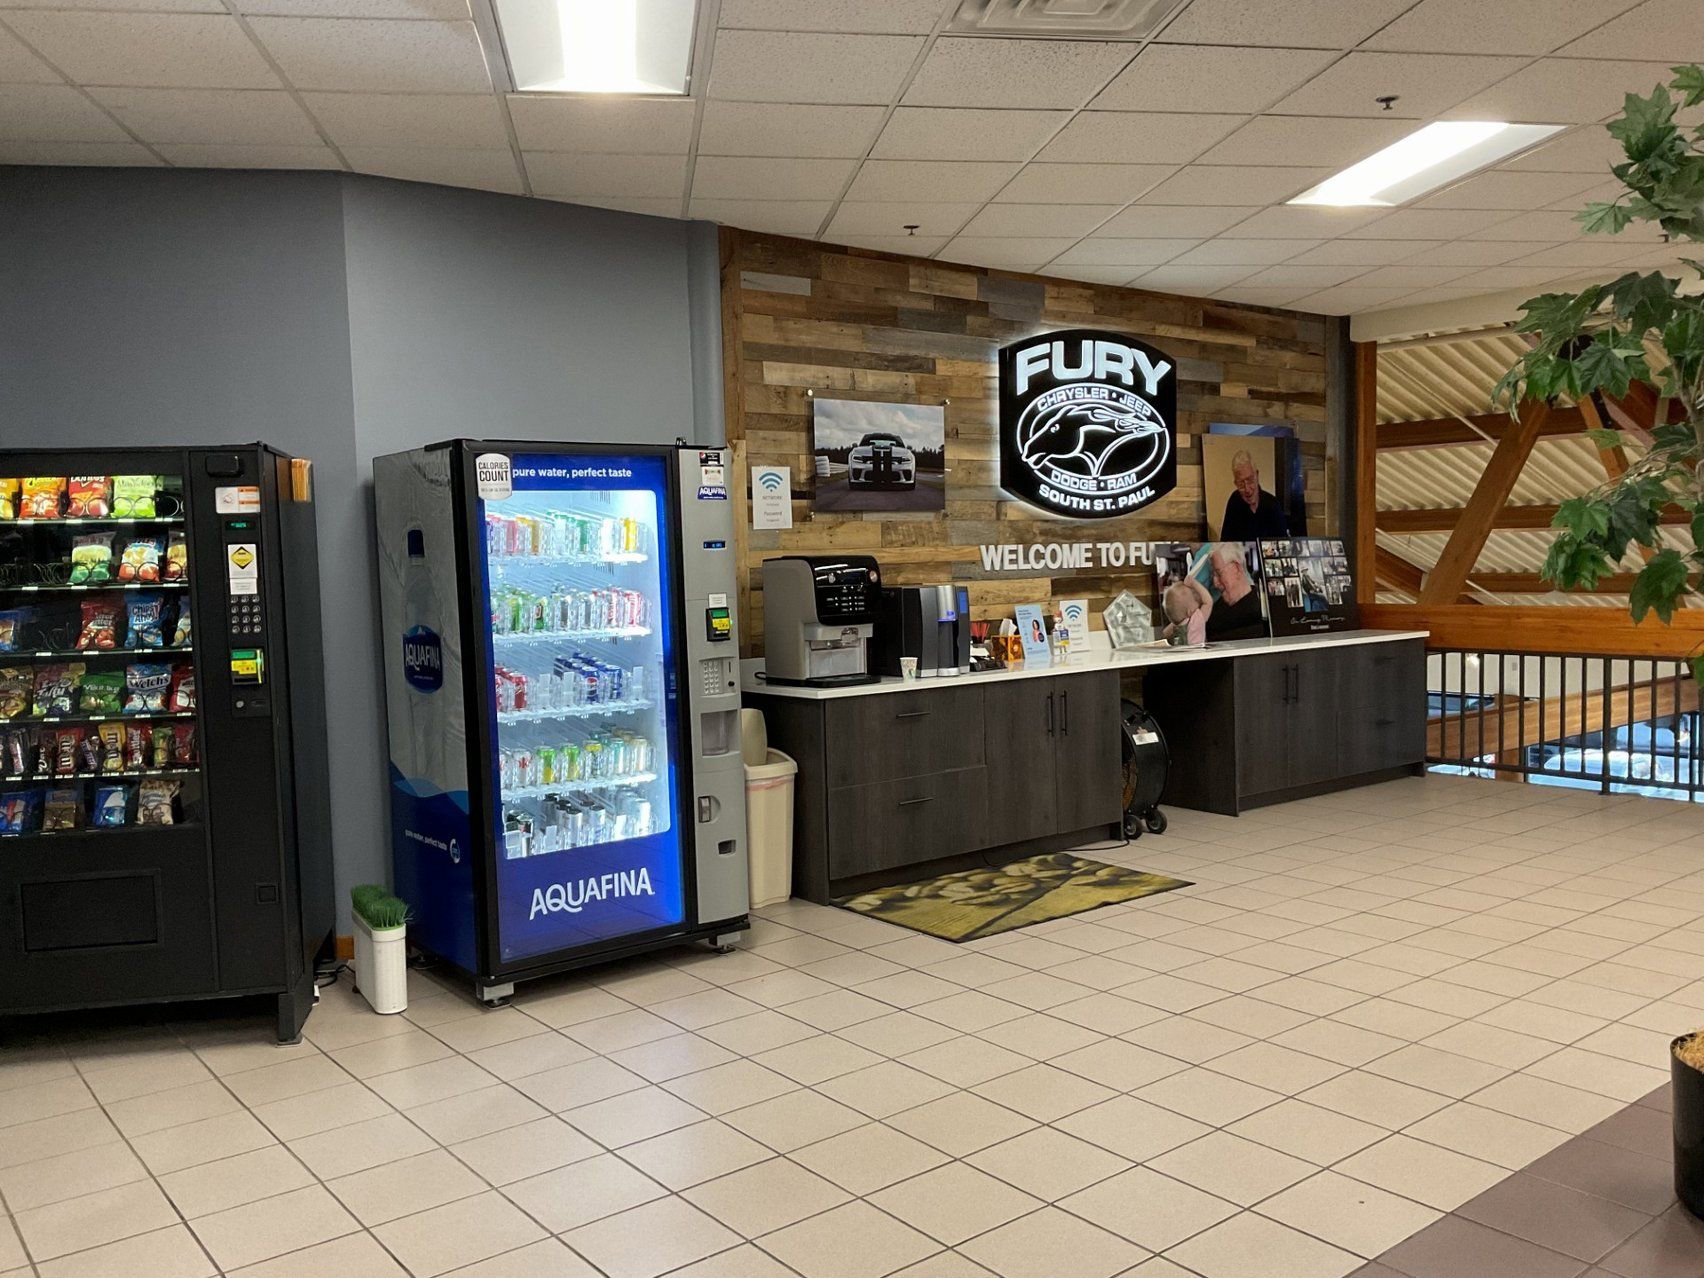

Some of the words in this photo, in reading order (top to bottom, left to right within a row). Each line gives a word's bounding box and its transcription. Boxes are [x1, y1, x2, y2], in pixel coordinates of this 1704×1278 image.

[1015, 340, 1172, 396] FURY
[1037, 387, 1109, 411] CHRYSLER
[1119, 394, 1151, 416] JEEP
[478, 461, 509, 470] CALORIES
[479, 470, 509, 482] COUNT
[513, 468, 536, 478] pure
[538, 468, 570, 478] water,
[572, 467, 606, 478] perfect
[608, 468, 632, 477] taste
[699, 487, 726, 496] AQUAFINA
[1051, 470, 1097, 491] DODGE
[1107, 472, 1137, 490] RAM
[1039, 483, 1091, 510] SOUTH
[1093, 499, 1116, 510] ST.
[1118, 486, 1155, 508] PAUL
[979, 542, 1094, 571] WELCOME
[1097, 541, 1126, 567] TO
[529, 867, 656, 920] AQUAFINA
